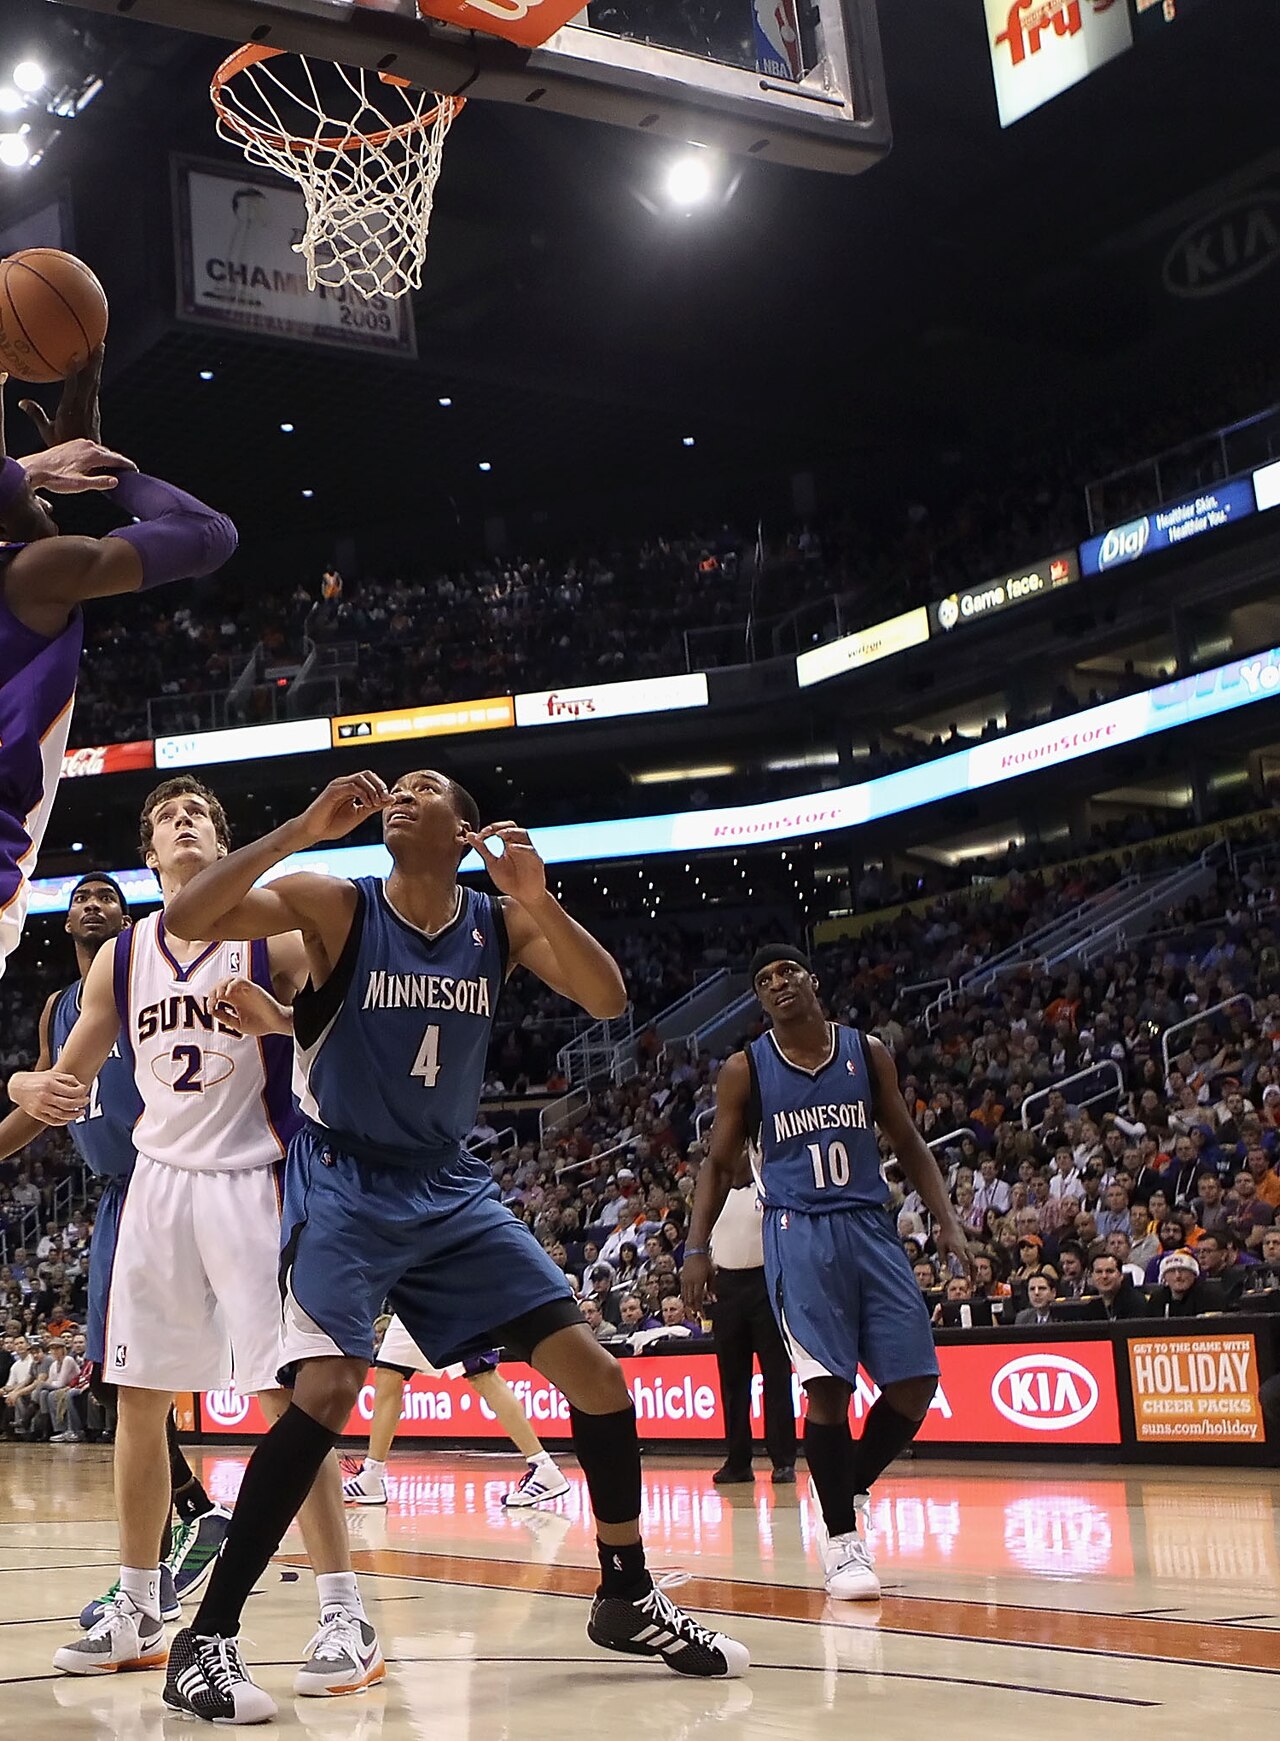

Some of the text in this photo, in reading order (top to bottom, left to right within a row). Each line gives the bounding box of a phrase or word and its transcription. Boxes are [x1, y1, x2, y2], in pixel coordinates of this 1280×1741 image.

[763, 58, 789, 79] NBA
[340, 304, 391, 333] 2009
[1103, 524, 1146, 563] Dial
[960, 586, 1004, 616] Game
[1006, 573, 1043, 601] face.
[543, 694, 596, 721] fry's
[1001, 721, 1117, 769] RoomStore
[714, 806, 842, 836] RoomStore
[362, 971, 490, 1017] MINNESOTA
[170, 1045, 203, 1092] 2
[410, 1025, 440, 1087] 4
[773, 1101, 867, 1143] MINNESOTA
[808, 1141, 850, 1189] 10
[1133, 1340, 1250, 1353] GET TO THE GAME WITH
[1009, 1372, 1082, 1412] KIA
[1135, 1352, 1250, 1394] HOLIDAY
[1143, 1398, 1252, 1414] CHEER PACKS
[1141, 1419, 1258, 1439] suns.com/holiday
